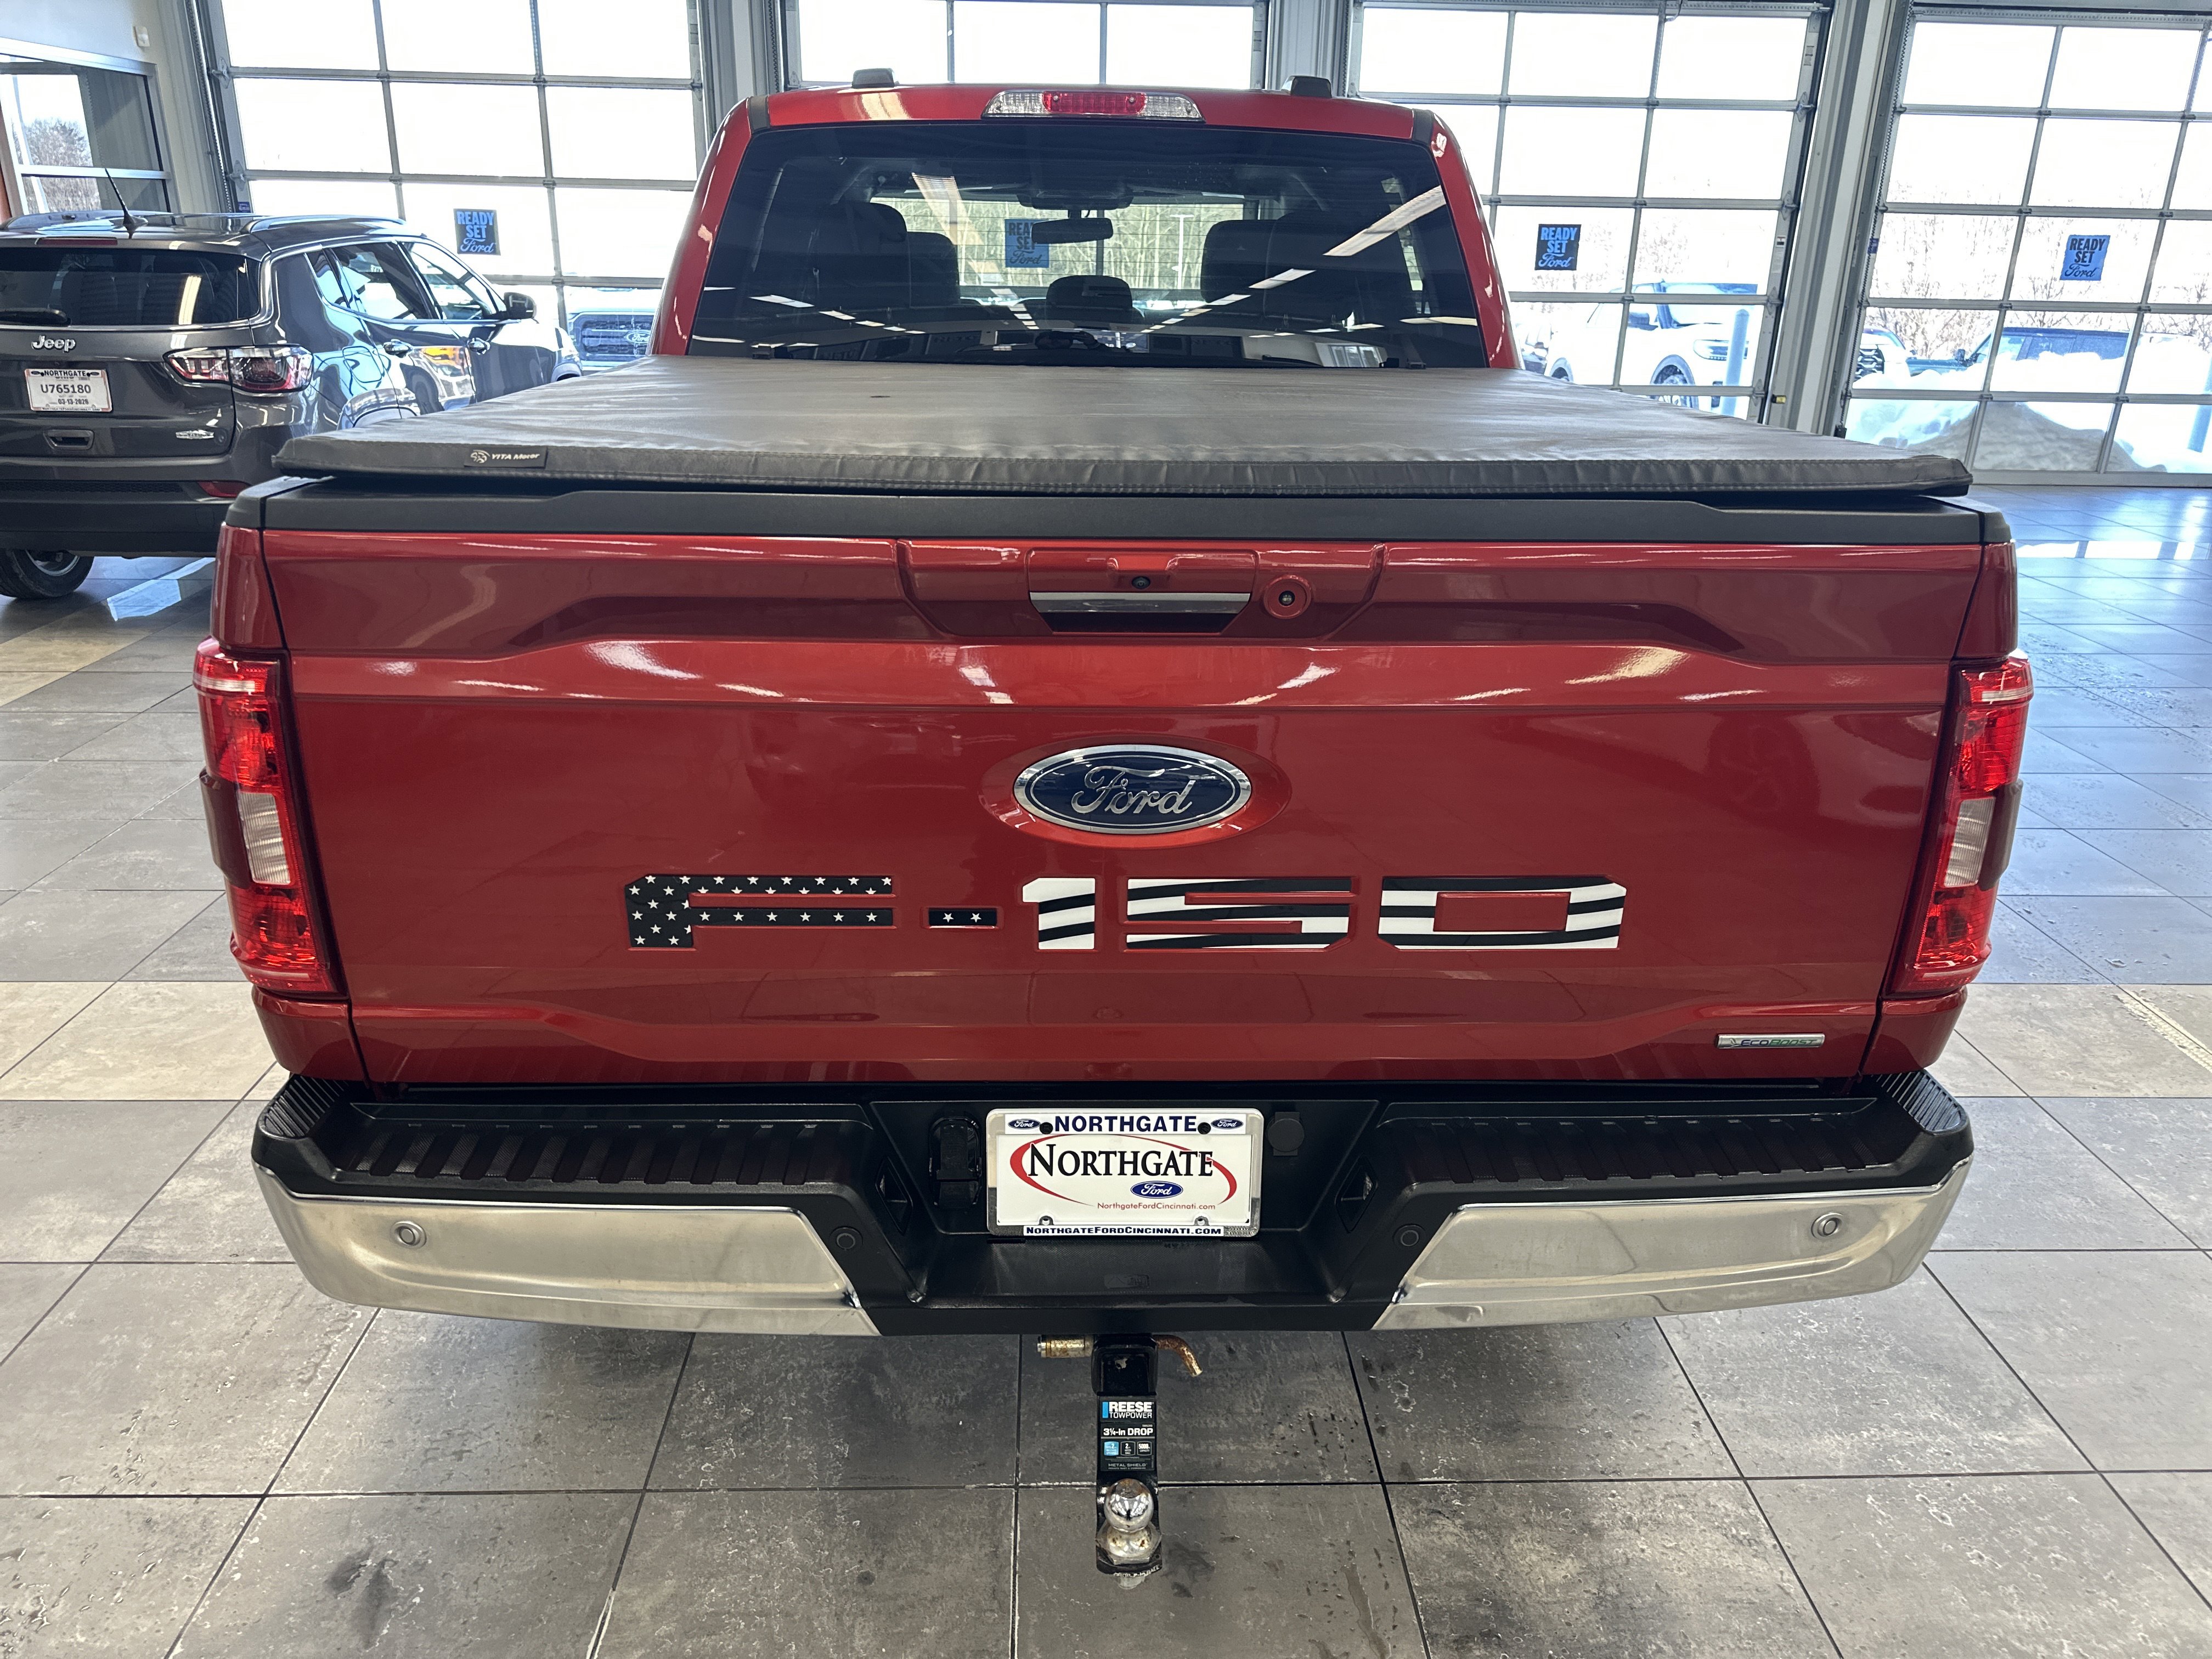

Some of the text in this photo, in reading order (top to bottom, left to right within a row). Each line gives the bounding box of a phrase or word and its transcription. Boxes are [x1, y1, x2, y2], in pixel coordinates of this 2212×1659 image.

[456, 211, 494, 225] READY
[466, 224, 487, 238] SET
[1008, 222, 1035, 236] REA
[1541, 227, 1578, 241] READY
[460, 238, 496, 253] Ford
[1547, 240, 1568, 253] SET
[2069, 238, 2106, 251] READY
[1009, 250, 1042, 264] Ford
[1538, 253, 1574, 267] Ford
[2074, 251, 2095, 263] SET
[2064, 263, 2098, 278] Ford
[32, 335, 76, 353] Jeep
[41, 384, 91, 394] U765180
[1071, 766, 1197, 815] Ford
[624, 875, 1627, 951] F-150
[1054, 1115, 1197, 1132] NORTHGATE
[1028, 1143, 1214, 1177] NORTHGATE
[1141, 1183, 1172, 1195] Ford
[1097, 1202, 1216, 1210] NorthgateFordCincinnati.com
[1109, 1401, 1152, 1413] REESE
[1127, 1427, 1153, 1436] DROP
